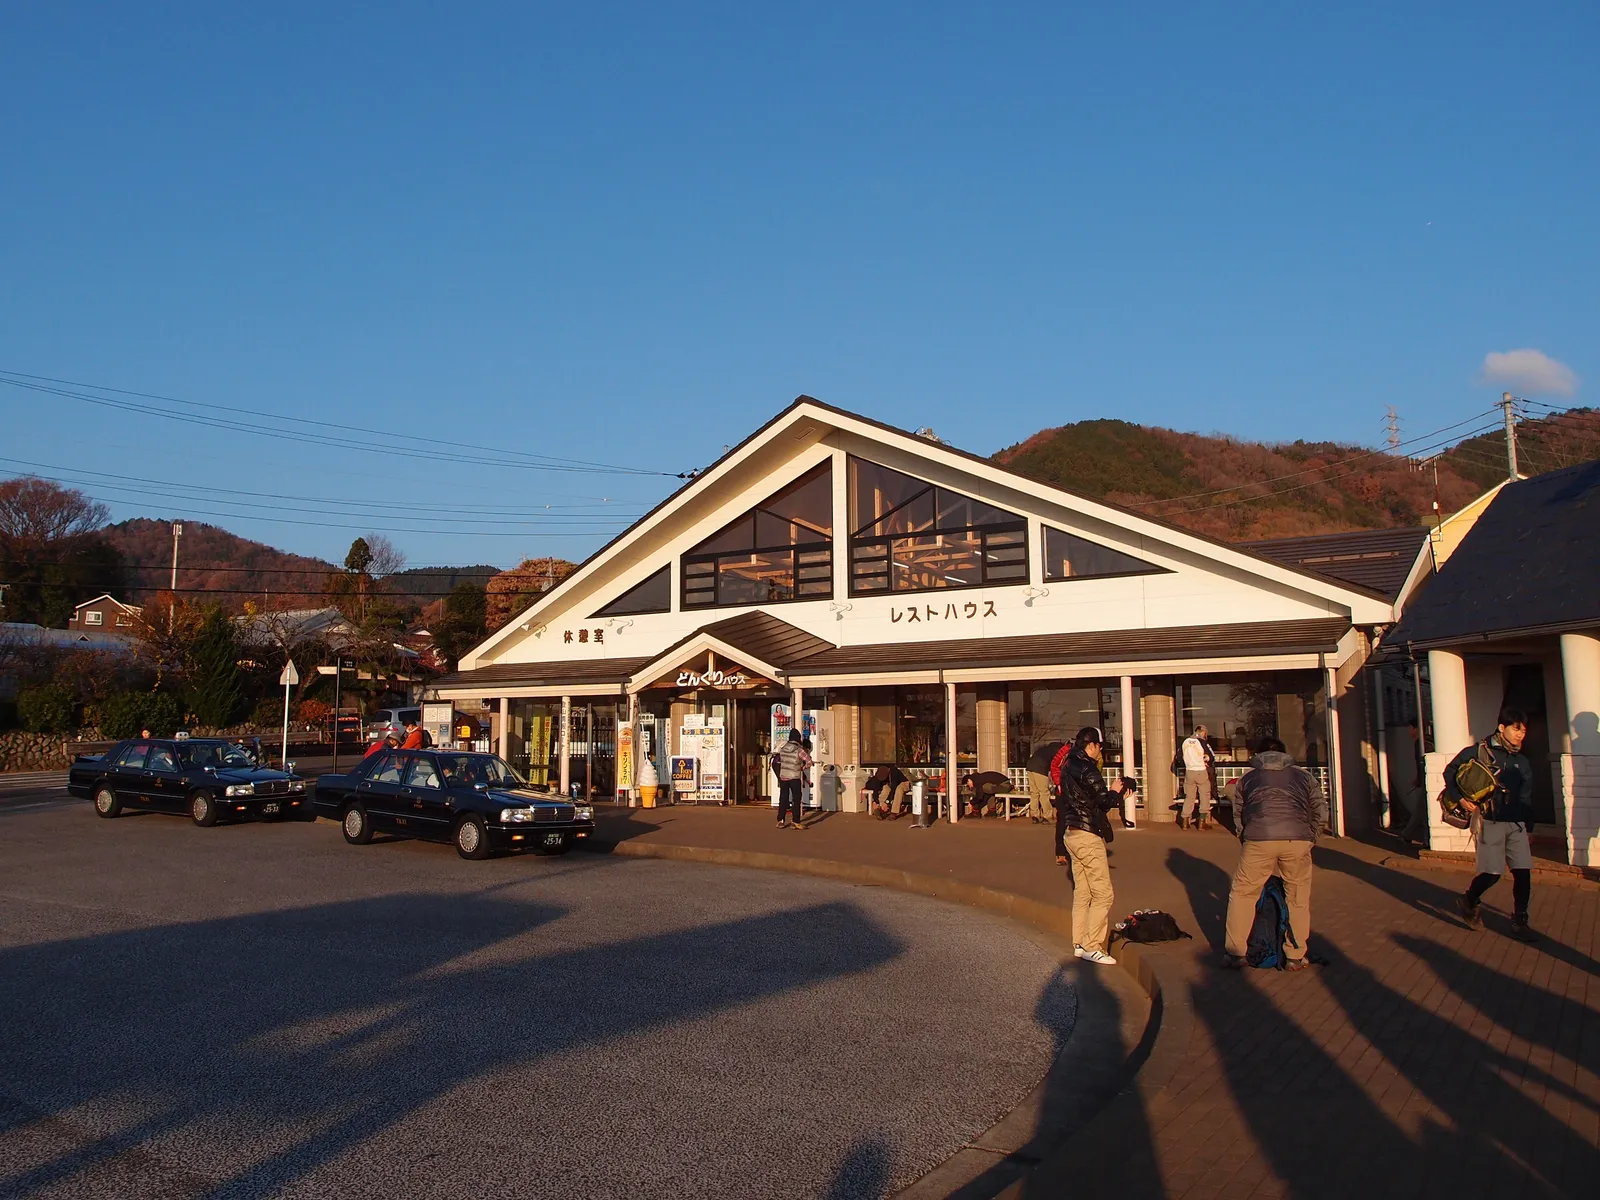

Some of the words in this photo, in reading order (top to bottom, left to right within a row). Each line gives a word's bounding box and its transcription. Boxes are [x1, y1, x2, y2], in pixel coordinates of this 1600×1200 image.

[891, 600, 997, 623] レストハウス
[563, 628, 604, 645] 休憩室
[676, 671, 746, 687] どんぐりハウス
[395, 817, 407, 825] TAXI
